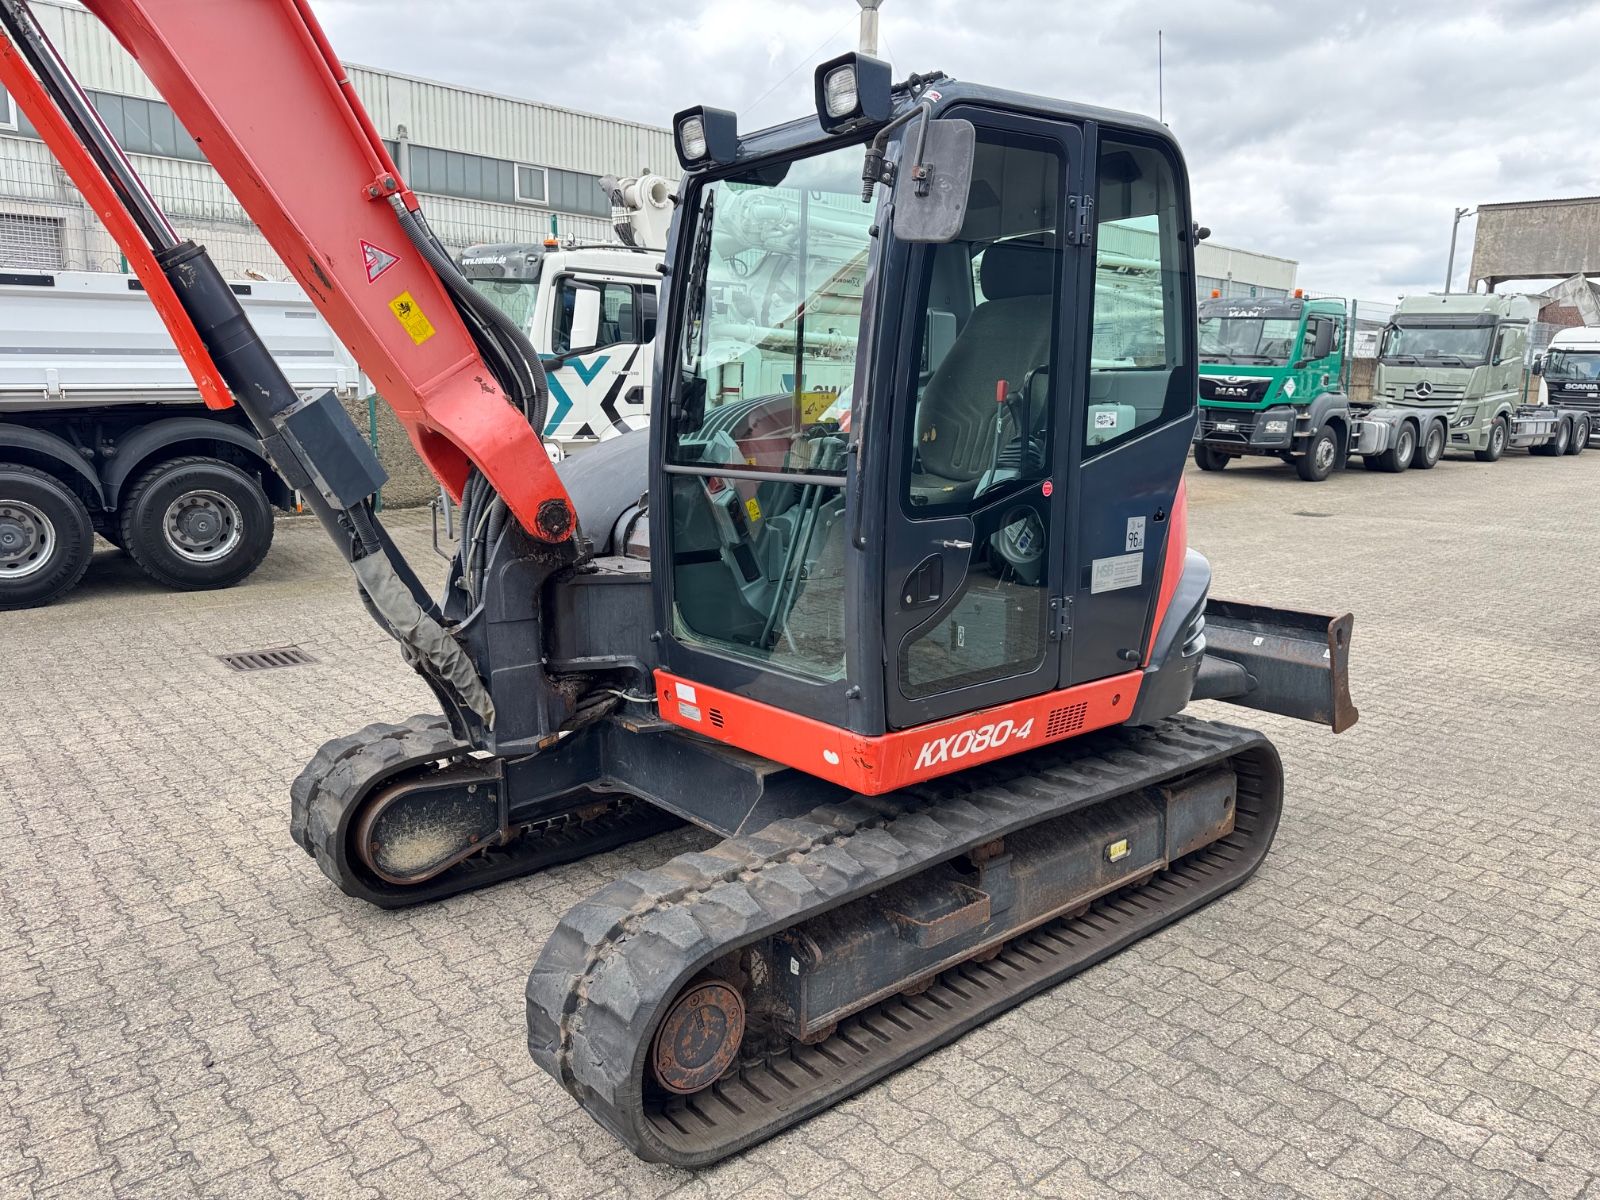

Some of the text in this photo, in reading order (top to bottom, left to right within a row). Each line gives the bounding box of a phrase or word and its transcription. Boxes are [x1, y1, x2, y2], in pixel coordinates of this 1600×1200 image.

[1214, 387, 1248, 396] MAN
[1128, 532, 1139, 548] 96
[913, 717, 1035, 771] KX080-4
